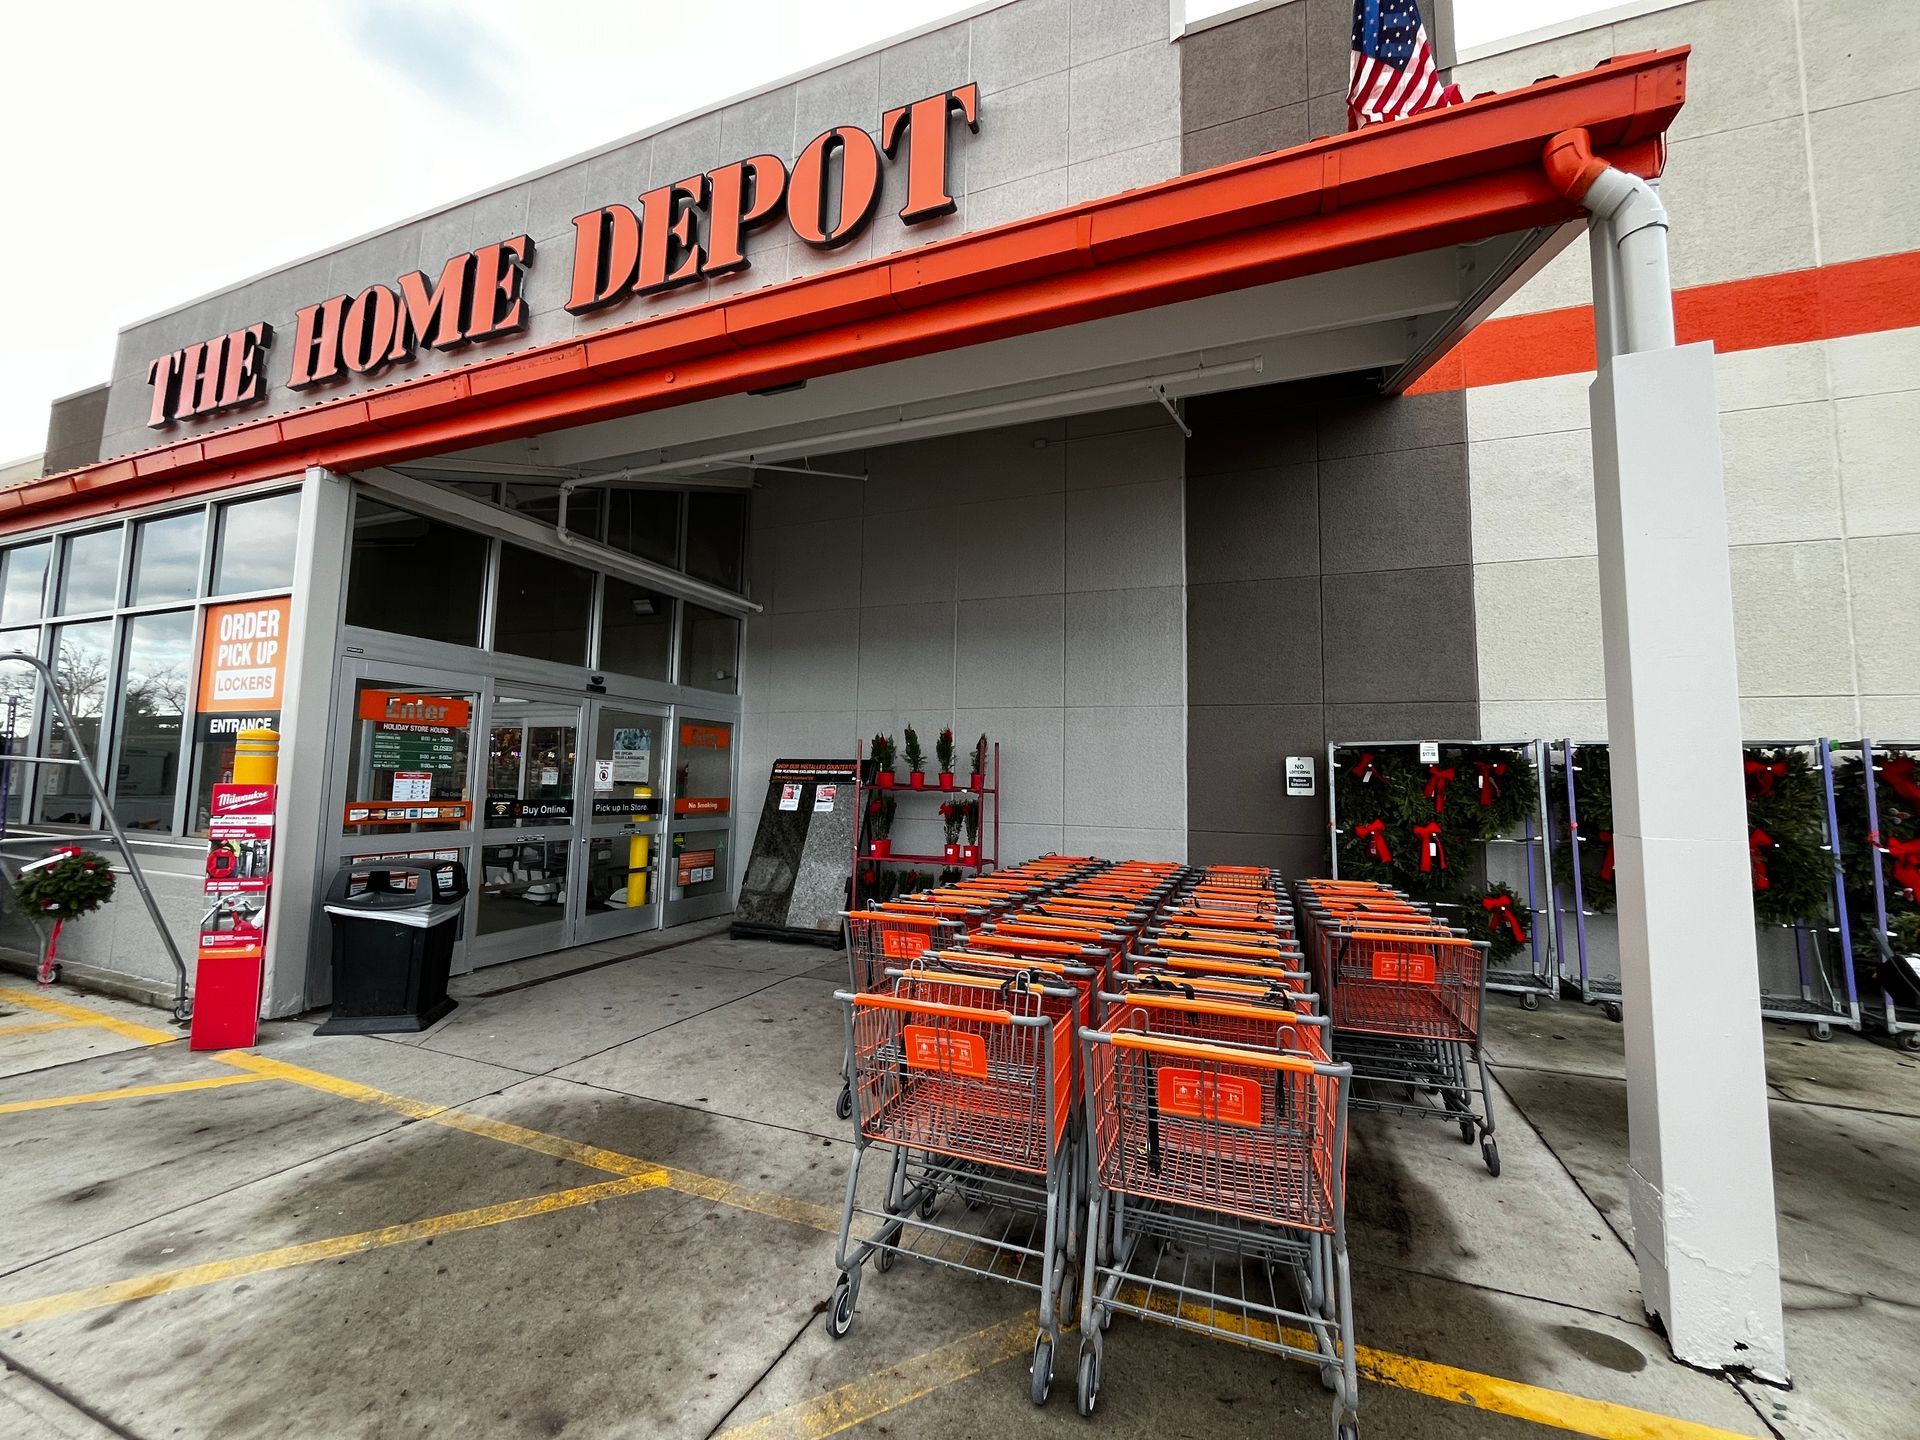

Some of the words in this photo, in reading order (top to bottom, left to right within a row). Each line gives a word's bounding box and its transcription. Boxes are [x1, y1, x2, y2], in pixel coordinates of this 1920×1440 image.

[148, 321, 273, 429] THE
[287, 233, 536, 392] HOME
[564, 81, 982, 317] DEPOT
[220, 608, 281, 642] ORDER
[217, 641, 253, 668] PICK
[255, 640, 278, 666] UP
[217, 675, 272, 692] LOCKERS
[385, 696, 449, 721] Enter
[209, 717, 272, 734] ENTRANCE
[383, 723, 409, 731] HOLIDAY
[409, 725, 429, 733] STORE
[216, 790, 269, 807] Milwaukee
[697, 802, 718, 810] Smoking
[522, 805, 539, 816] Buy
[540, 804, 568, 814] Online.
[595, 803, 611, 812] Pick
[612, 806, 621, 814] up
[622, 803, 629, 811] In
[630, 803, 649, 811] Store.
